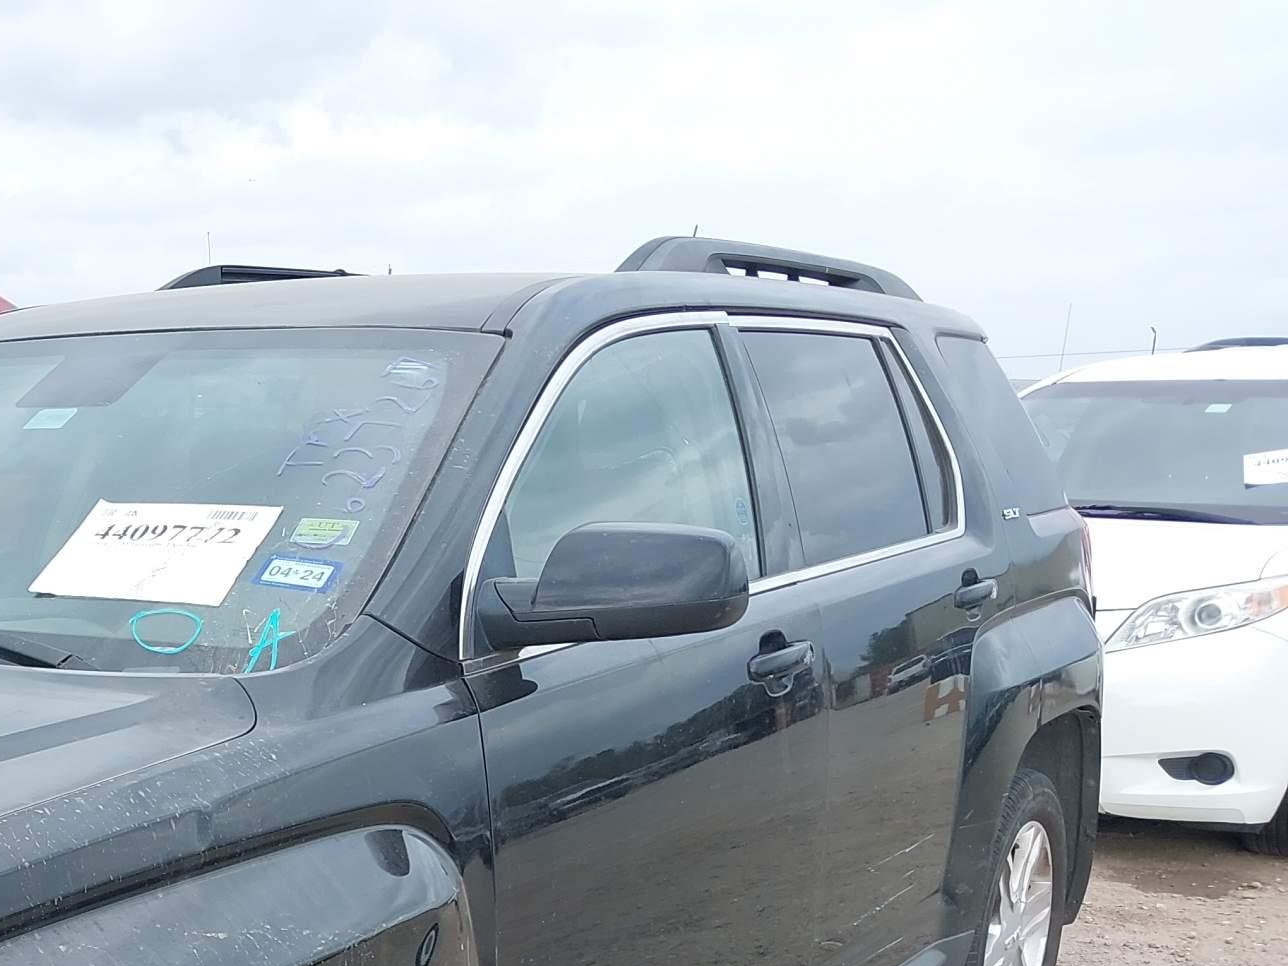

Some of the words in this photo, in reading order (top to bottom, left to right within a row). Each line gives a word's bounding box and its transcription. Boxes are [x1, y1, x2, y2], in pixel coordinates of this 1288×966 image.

[1003, 507, 1021, 520] SLT
[94, 523, 242, 544] 44097772
[269, 565, 293, 578] 04
[300, 569, 325, 582] 24
